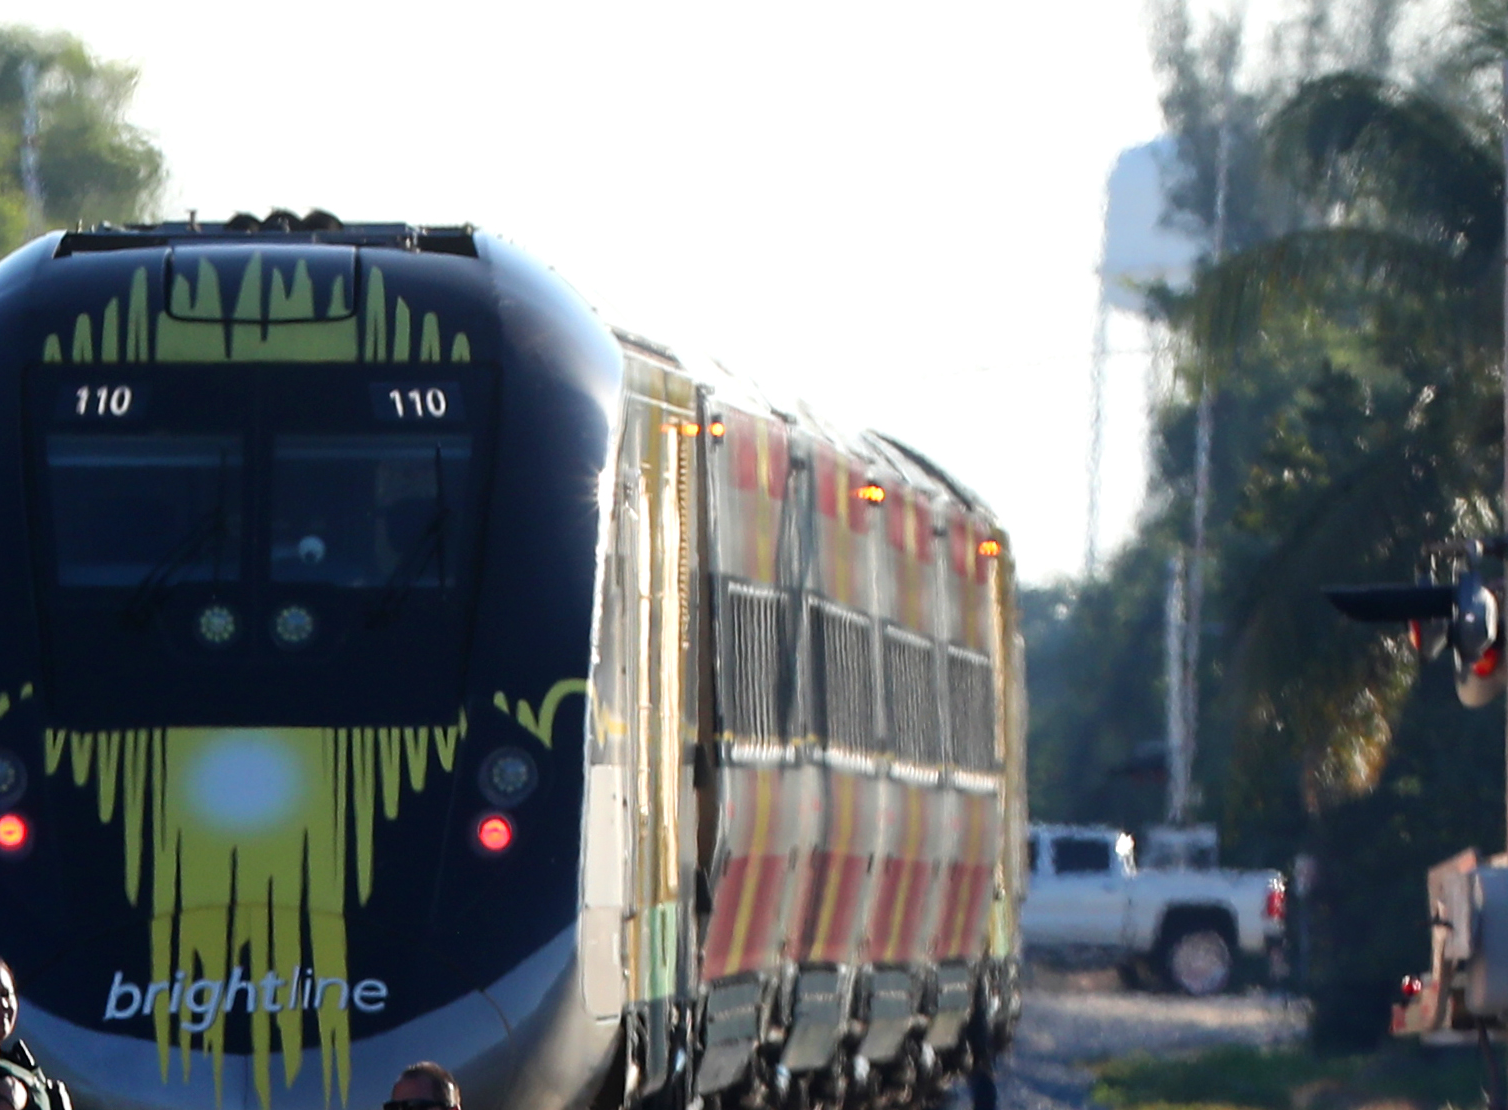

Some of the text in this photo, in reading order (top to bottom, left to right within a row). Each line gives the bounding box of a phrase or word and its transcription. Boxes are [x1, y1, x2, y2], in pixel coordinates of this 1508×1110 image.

[75, 385, 133, 417] 110
[388, 387, 447, 419] 110
[103, 966, 389, 1033] brightline
